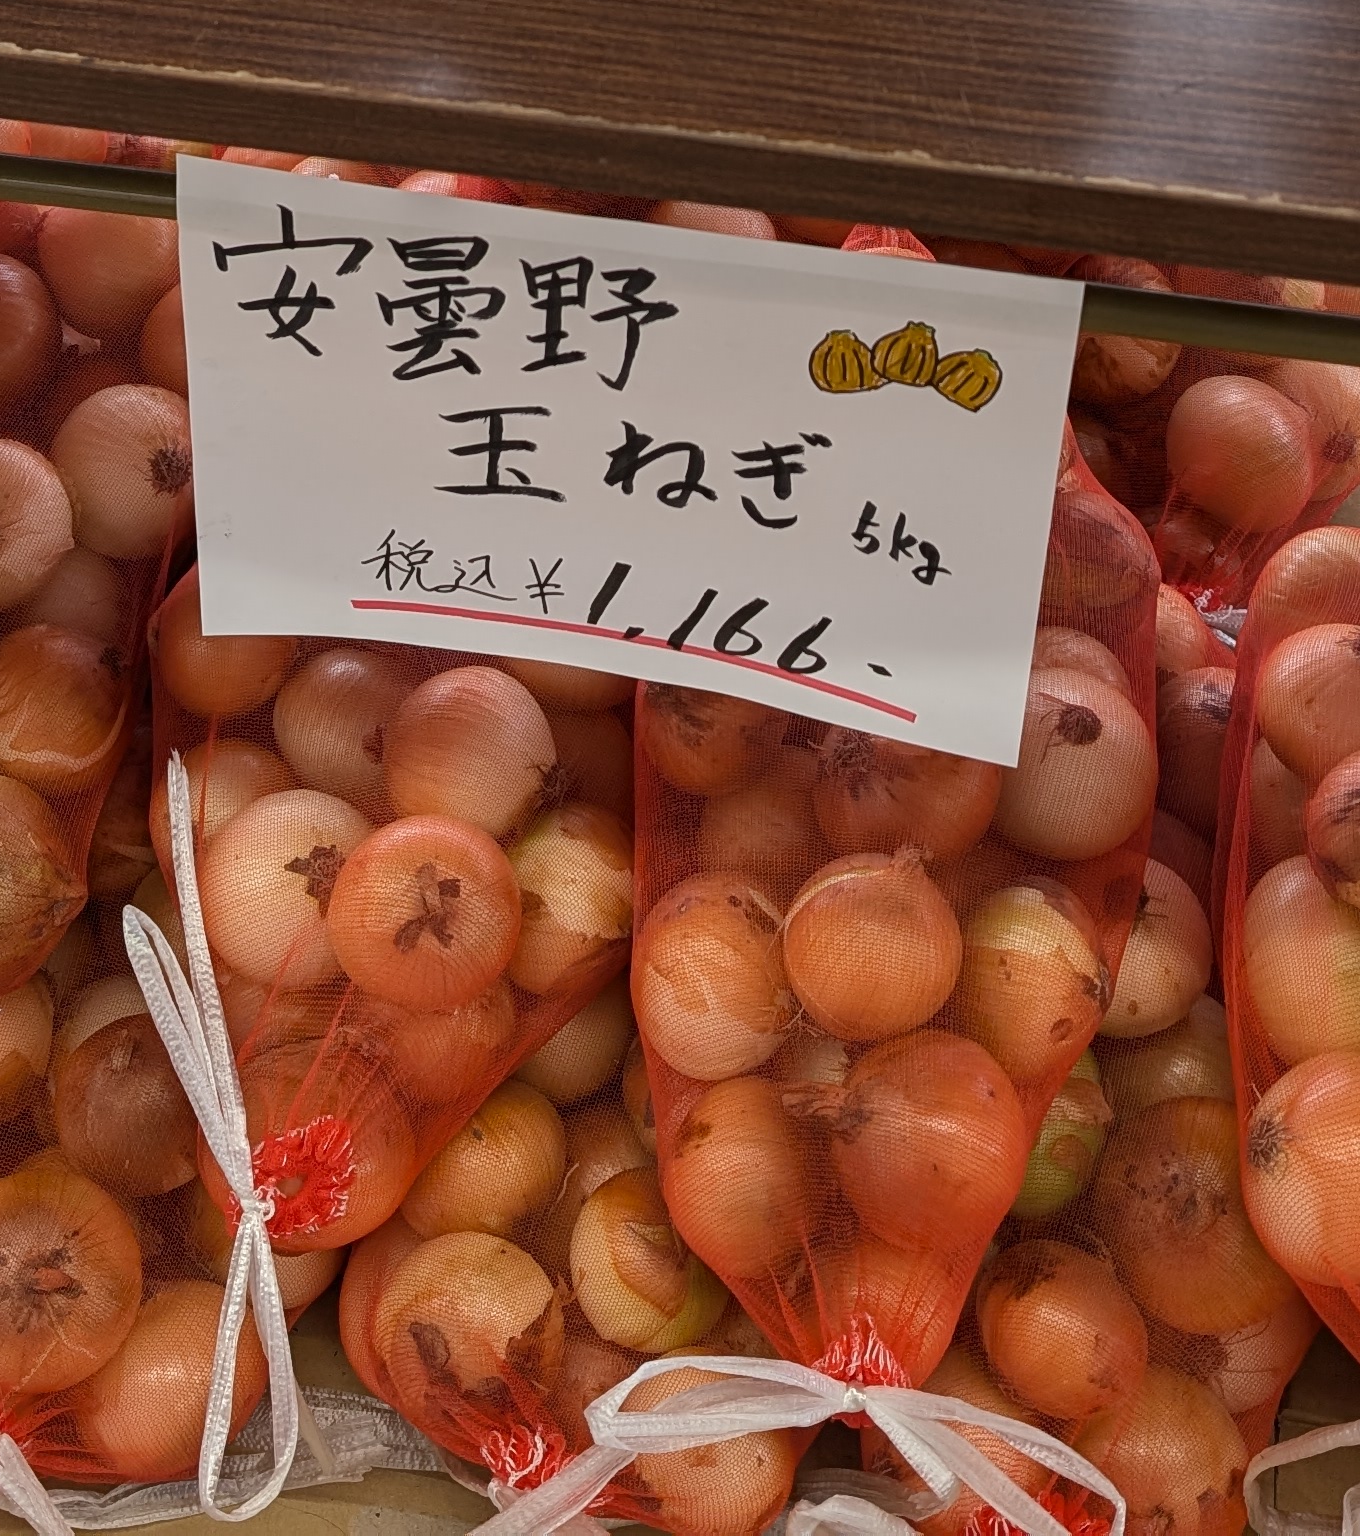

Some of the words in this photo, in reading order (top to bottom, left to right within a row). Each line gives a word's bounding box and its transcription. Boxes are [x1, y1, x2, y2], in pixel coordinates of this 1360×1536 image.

[212, 203, 681, 392] 安曇野
[434, 406, 833, 530] 玉ねぎ
[851, 500, 952, 586] 5kg
